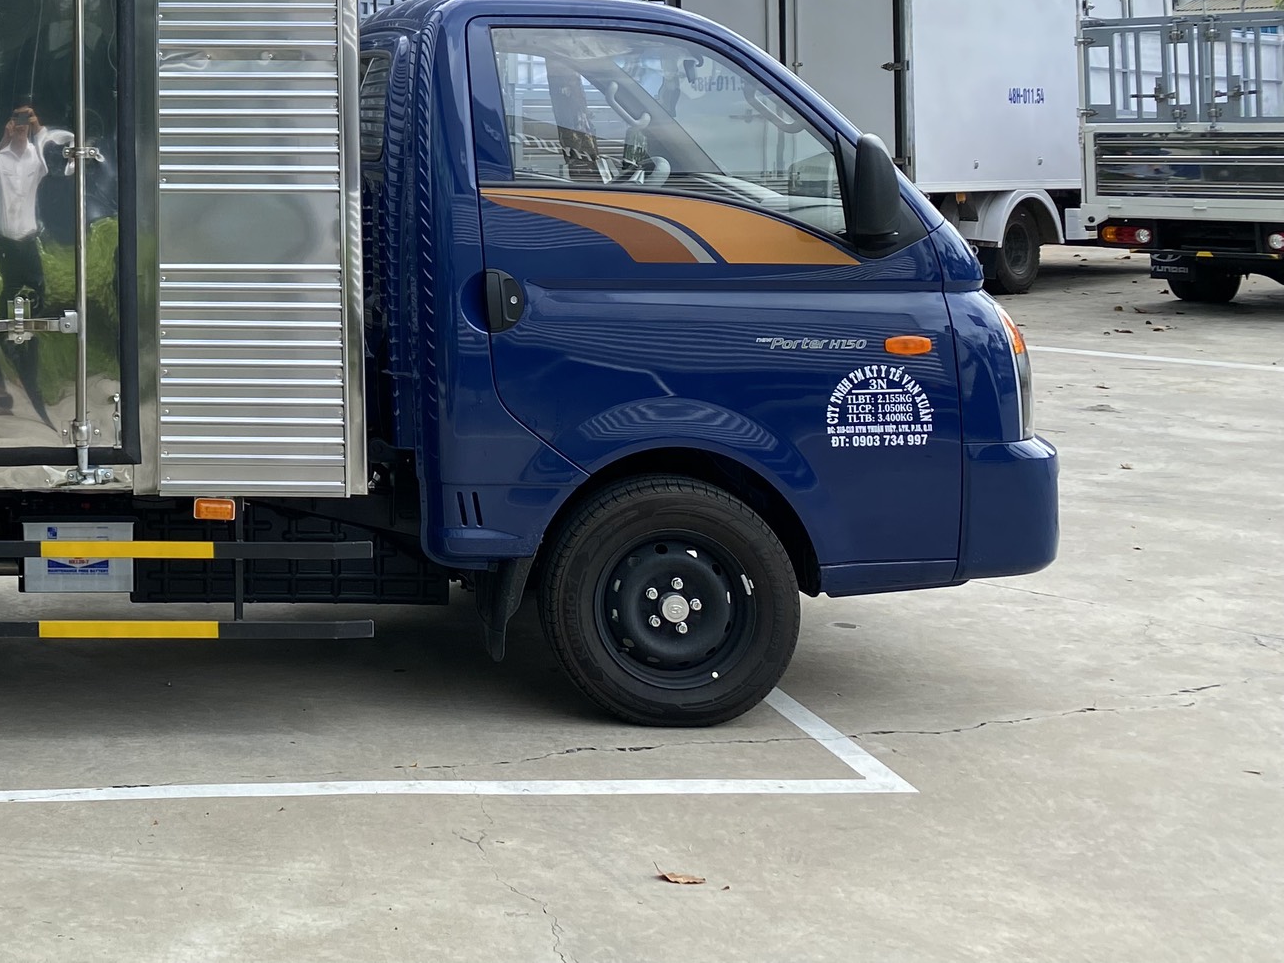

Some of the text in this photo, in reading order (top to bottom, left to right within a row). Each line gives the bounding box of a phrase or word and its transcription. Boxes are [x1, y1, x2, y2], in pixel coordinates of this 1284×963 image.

[1008, 87, 1045, 104] 48H-011.54
[770, 337, 828, 350] Porter
[829, 338, 867, 350] H150
[848, 368, 866, 384] TM
[880, 365, 888, 378] Y
[888, 365, 905, 382] TẾ
[829, 377, 853, 404] TNHH
[868, 378, 888, 390] 3N
[901, 373, 922, 396] VẠN
[846, 393, 913, 404] TLBT: 2.155KG
[826, 404, 840, 425] CTY
[846, 403, 913, 413] TLCP: 1.050KG
[914, 392, 935, 422] XUÂN
[846, 413, 914, 423] TLTB: 3.400KG
[831, 433, 929, 448] ĐT: 0903 734 997
